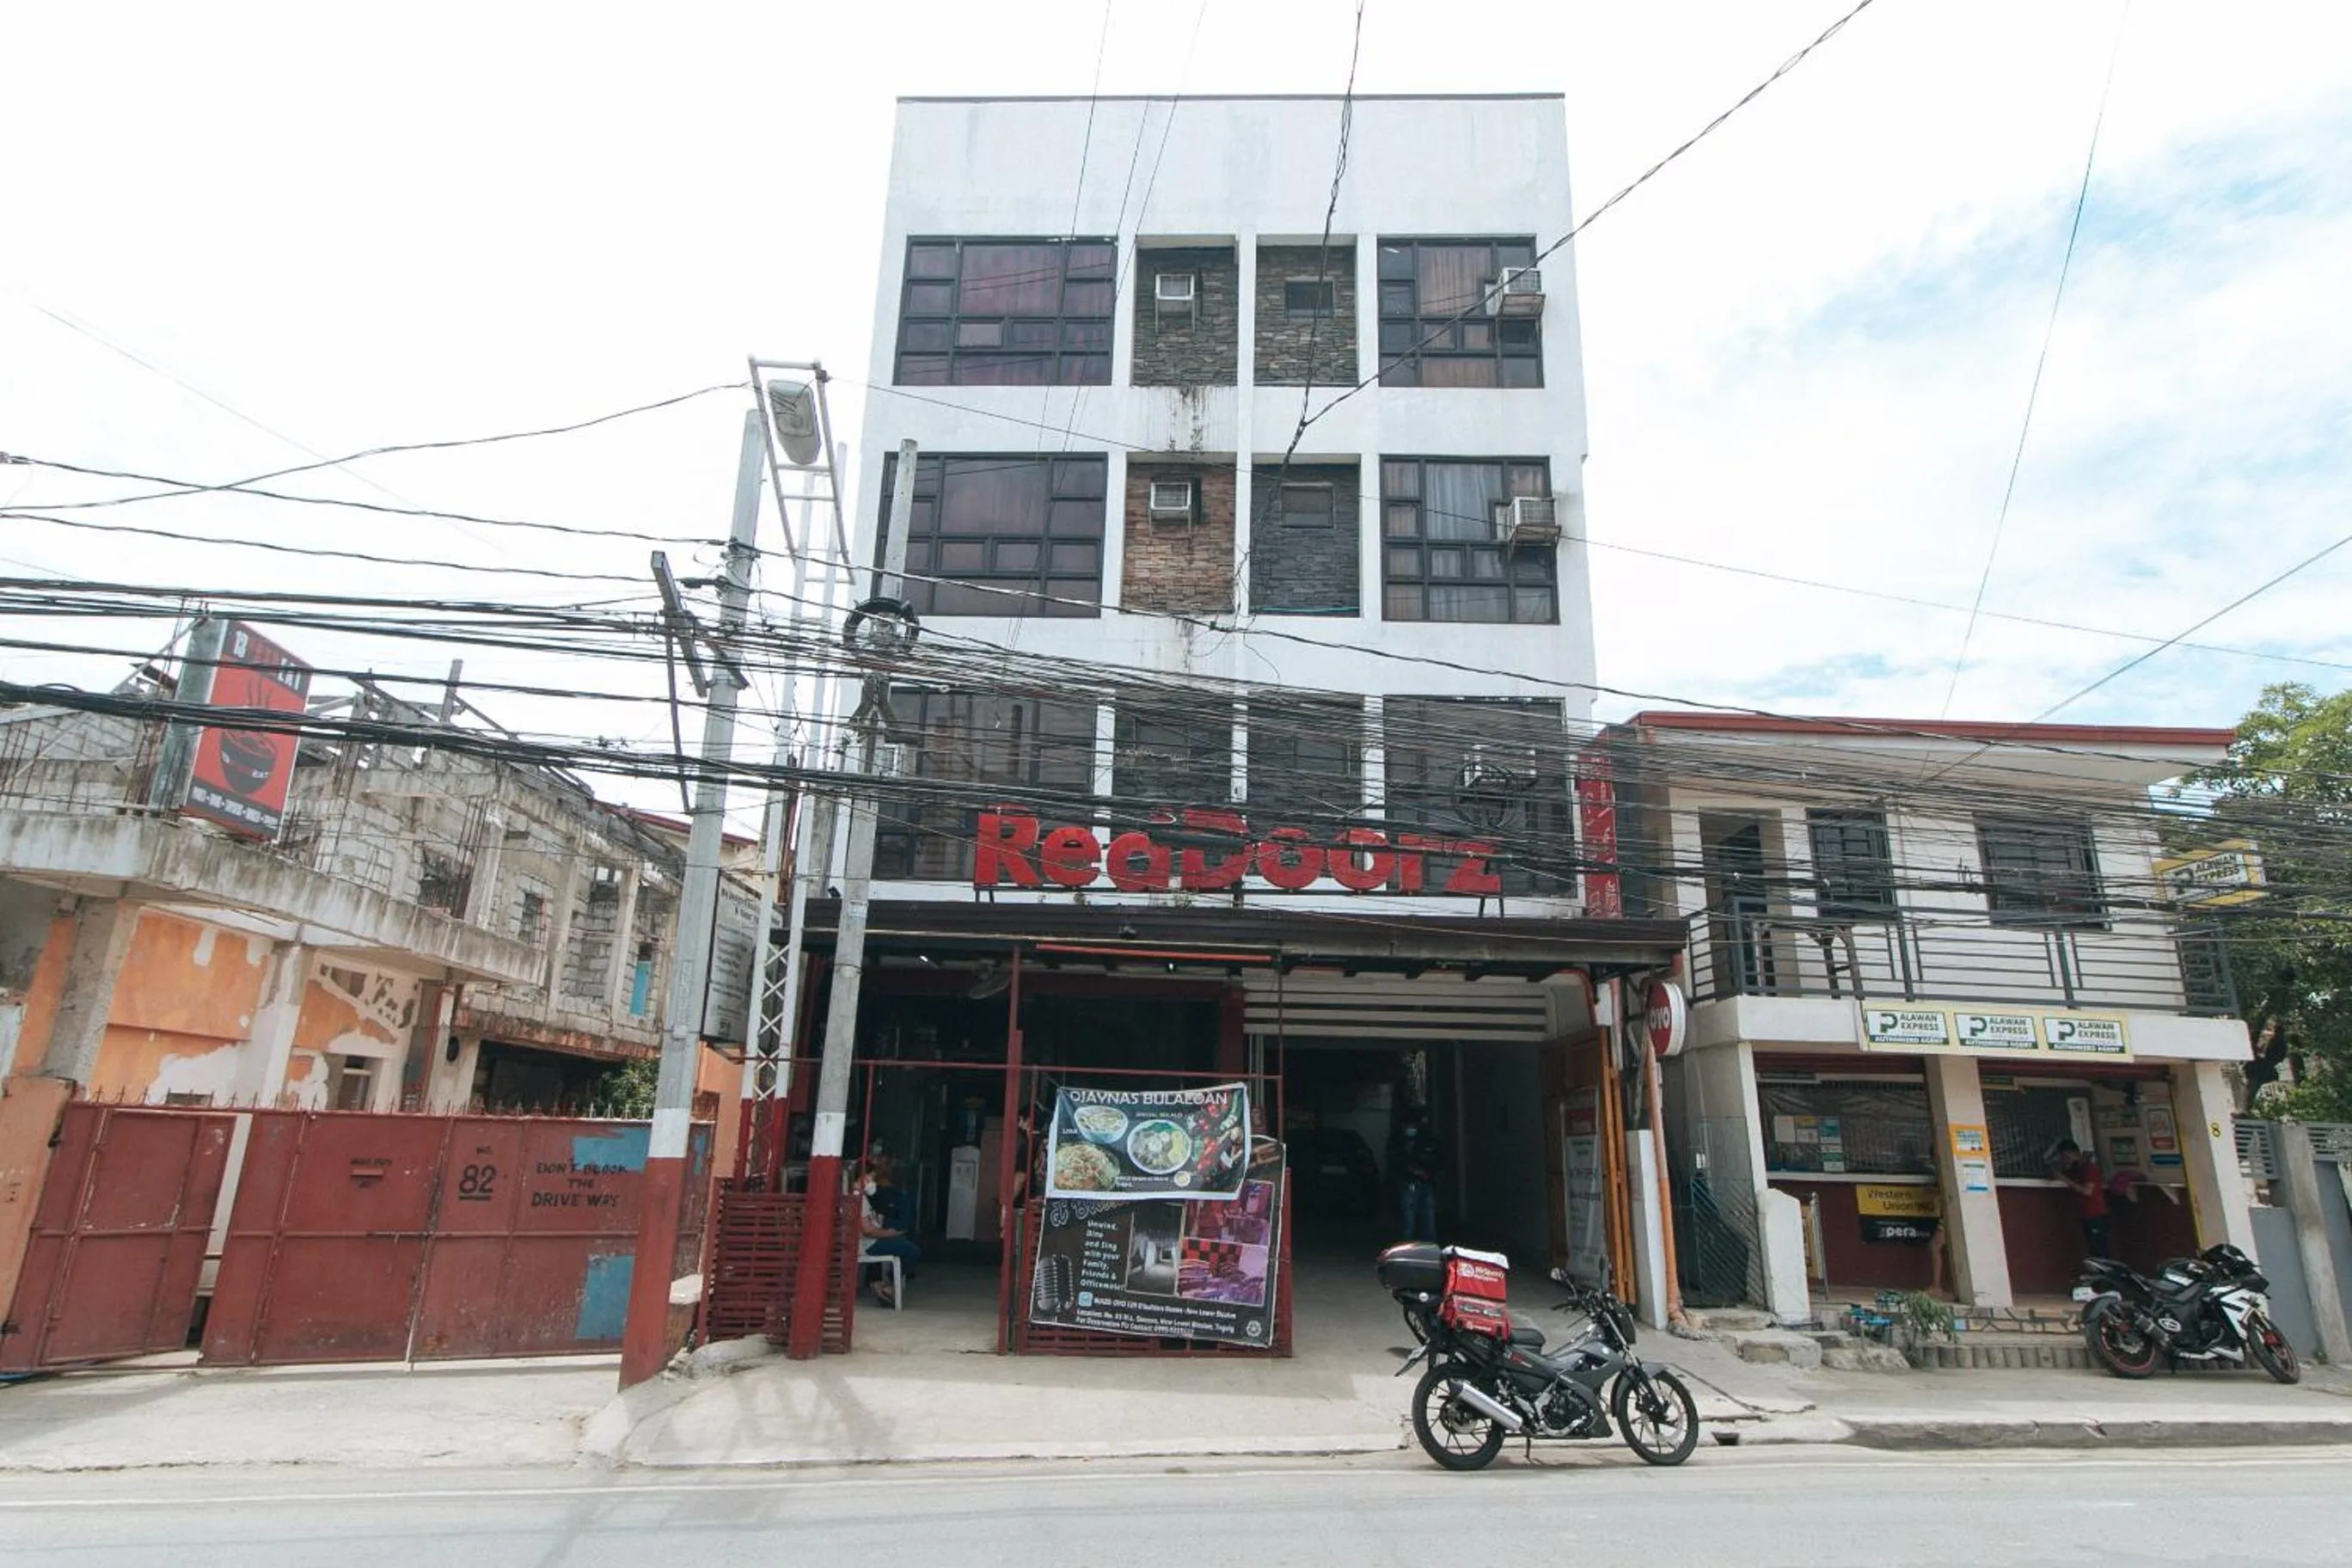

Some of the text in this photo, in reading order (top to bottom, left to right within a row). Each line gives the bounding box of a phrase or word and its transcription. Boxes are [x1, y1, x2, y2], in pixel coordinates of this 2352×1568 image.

[1649, 1008, 1671, 1030] OYO
[1901, 1022, 1939, 1032] EXPRESS
[1990, 1026, 2028, 1035] EXPRESS
[2078, 1030, 2116, 1039] EXPRESS
[1142, 1089, 1228, 1106] BULALOAN
[458, 1165, 498, 1193] 82
[568, 1179, 594, 1190] THE
[530, 1192, 621, 1208] DRIVE WAY
[1867, 1187, 1912, 1201] Western
